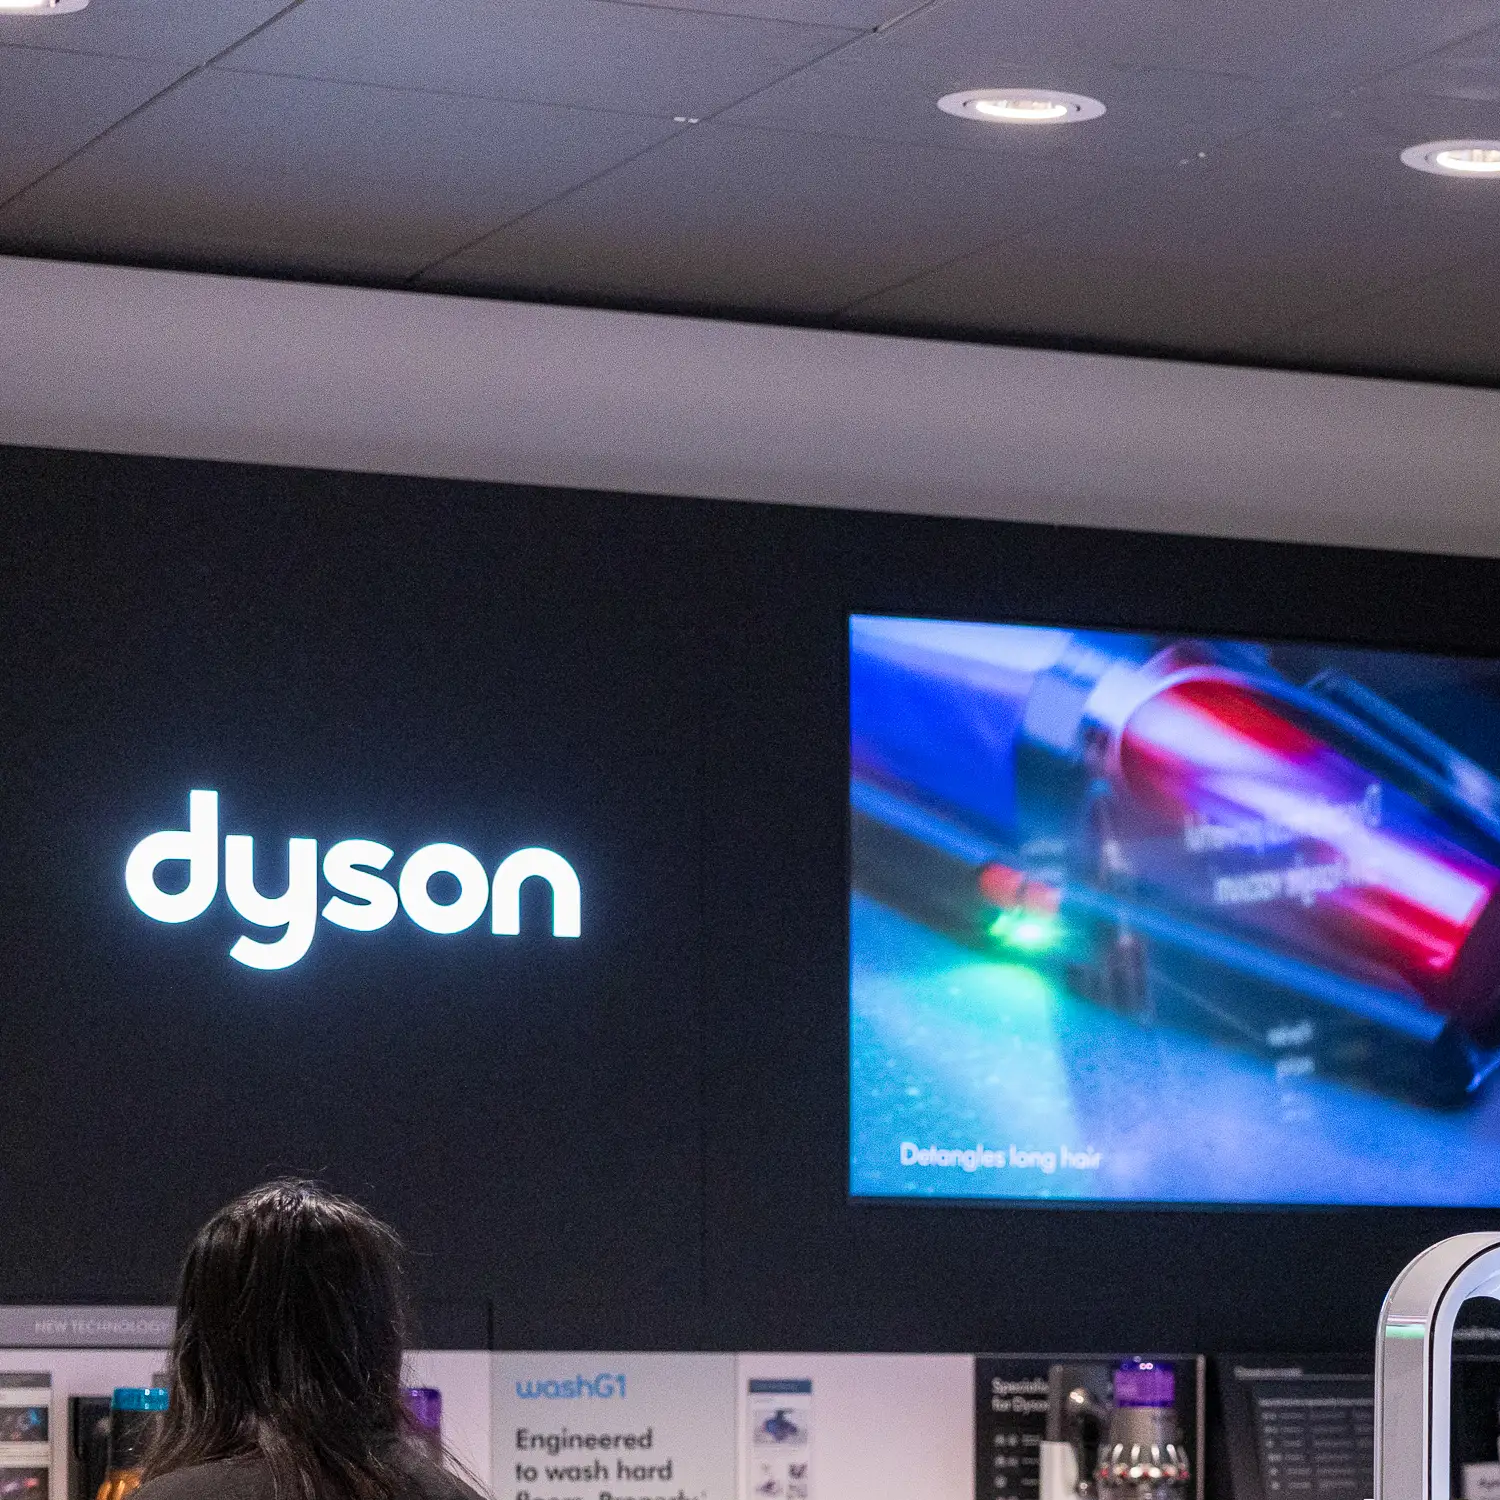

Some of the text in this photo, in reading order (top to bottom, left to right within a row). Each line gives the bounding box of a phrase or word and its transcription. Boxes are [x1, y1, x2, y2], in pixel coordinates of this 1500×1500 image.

[125, 788, 582, 971] dyson
[900, 1141, 1103, 1174] Detangles long hair
[515, 1373, 626, 1398] washG1
[515, 1426, 653, 1456] Engineered
[515, 1457, 673, 1482] to wash hard
